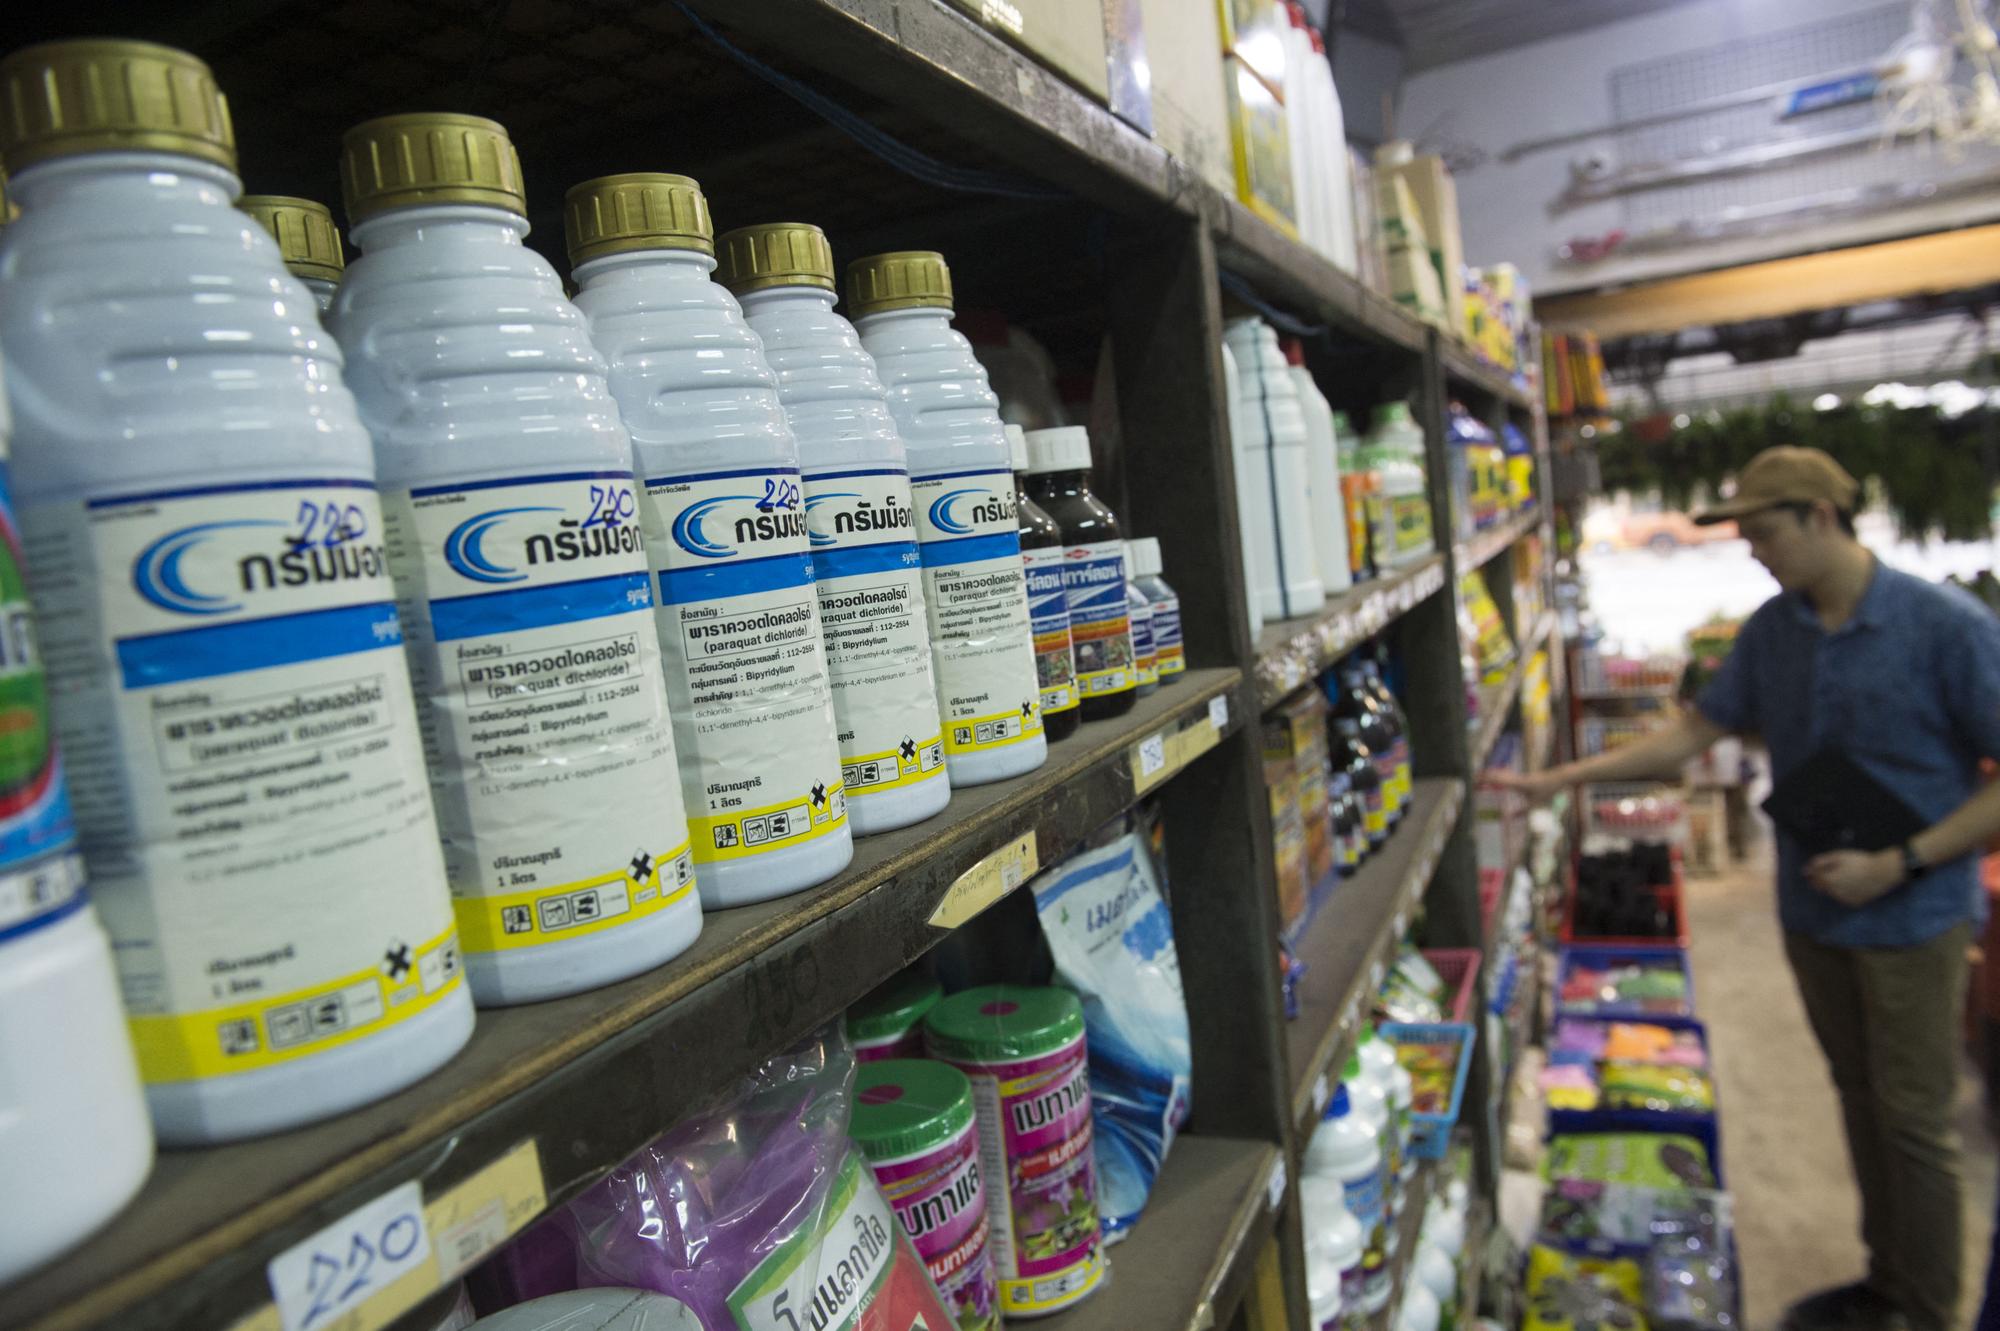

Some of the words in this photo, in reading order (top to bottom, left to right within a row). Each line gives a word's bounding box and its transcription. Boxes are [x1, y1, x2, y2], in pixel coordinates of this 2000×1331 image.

[755, 478, 799, 509] 220
[296, 501, 368, 552] 220
[680, 607, 718, 620] ชื่อสามัญ
[859, 602, 904, 618] dichloride)
[689, 603, 812, 640] พาราควอตไดคลอไรด์
[880, 619, 910, 632] 112-2554
[704, 635, 762, 655] (paraquat
[764, 625, 808, 644] dichloride)
[842, 636, 888, 651] Bipyridylium
[746, 664, 796, 682] Bipyridylium
[707, 775, 763, 796] ปริมาณสุทธิ
[710, 799, 717, 810] 1
[721, 796, 743, 808] ลิตร
